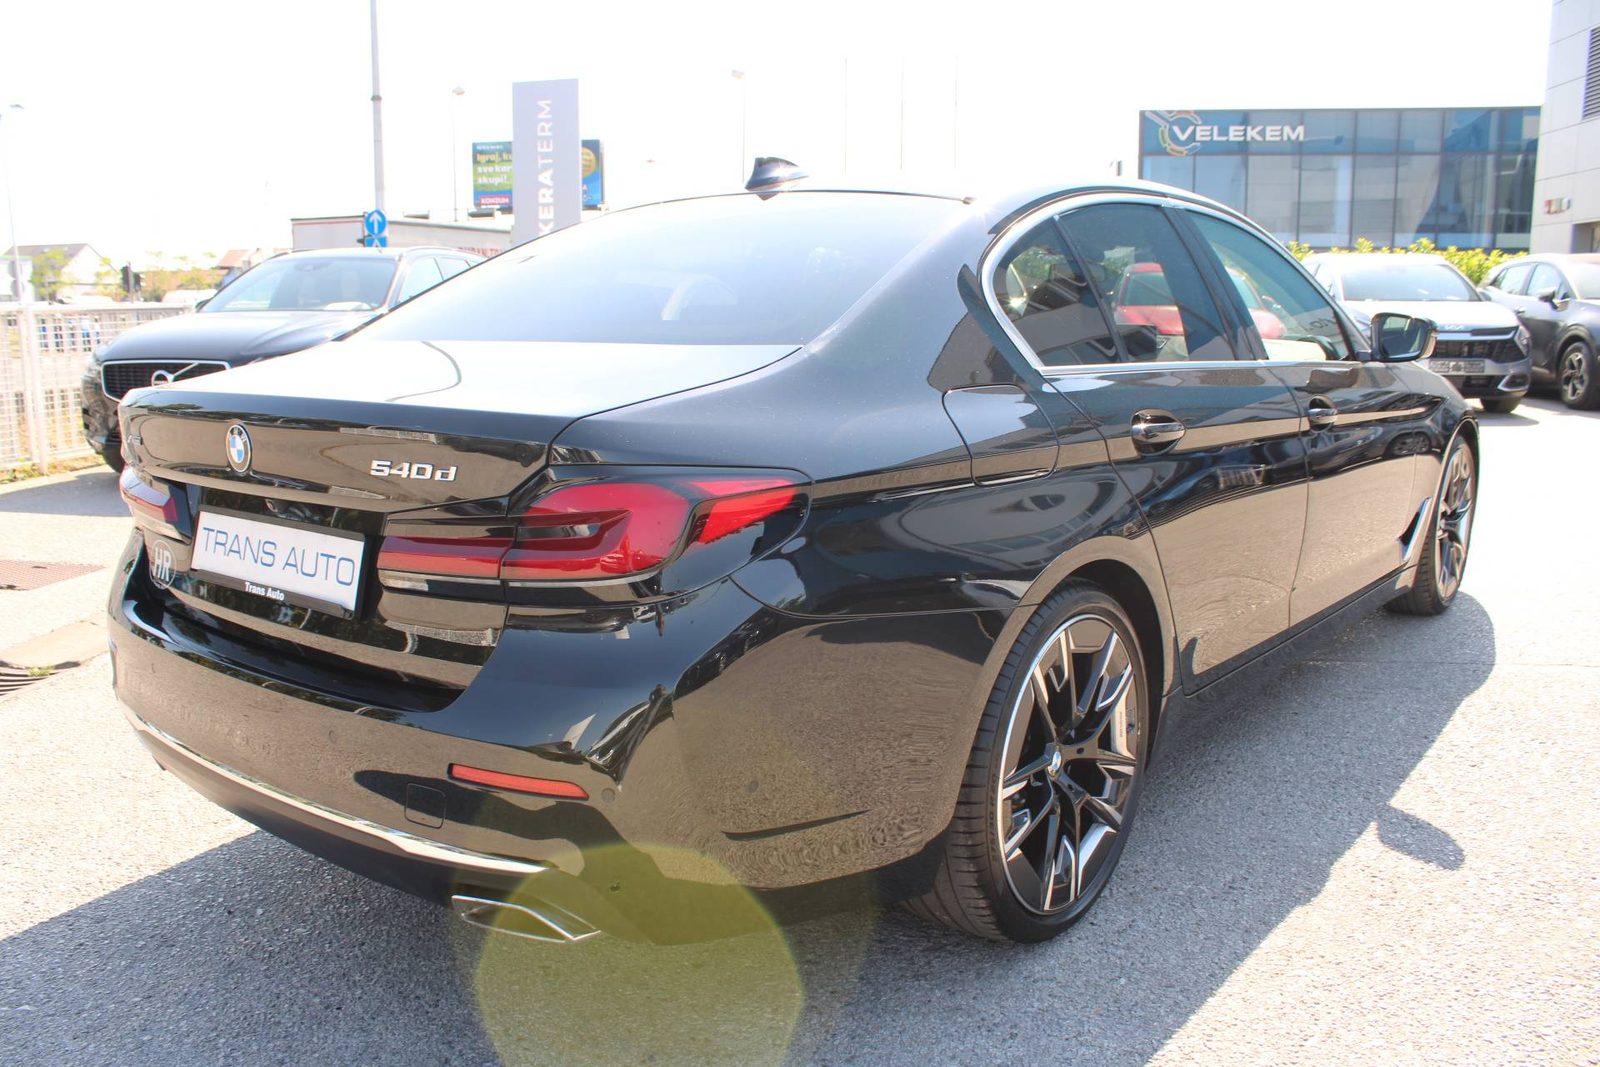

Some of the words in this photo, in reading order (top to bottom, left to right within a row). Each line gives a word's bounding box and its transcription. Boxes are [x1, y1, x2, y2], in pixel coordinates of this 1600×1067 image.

[1172, 125, 1305, 141] VELEKEM
[537, 99, 553, 235] KERATERM
[370, 460, 457, 481] 540d
[154, 549, 172, 582] HR
[202, 527, 277, 568] TRANS
[282, 546, 355, 587] AUTO
[244, 581, 265, 597] Trans
[266, 586, 285, 601] Auto
